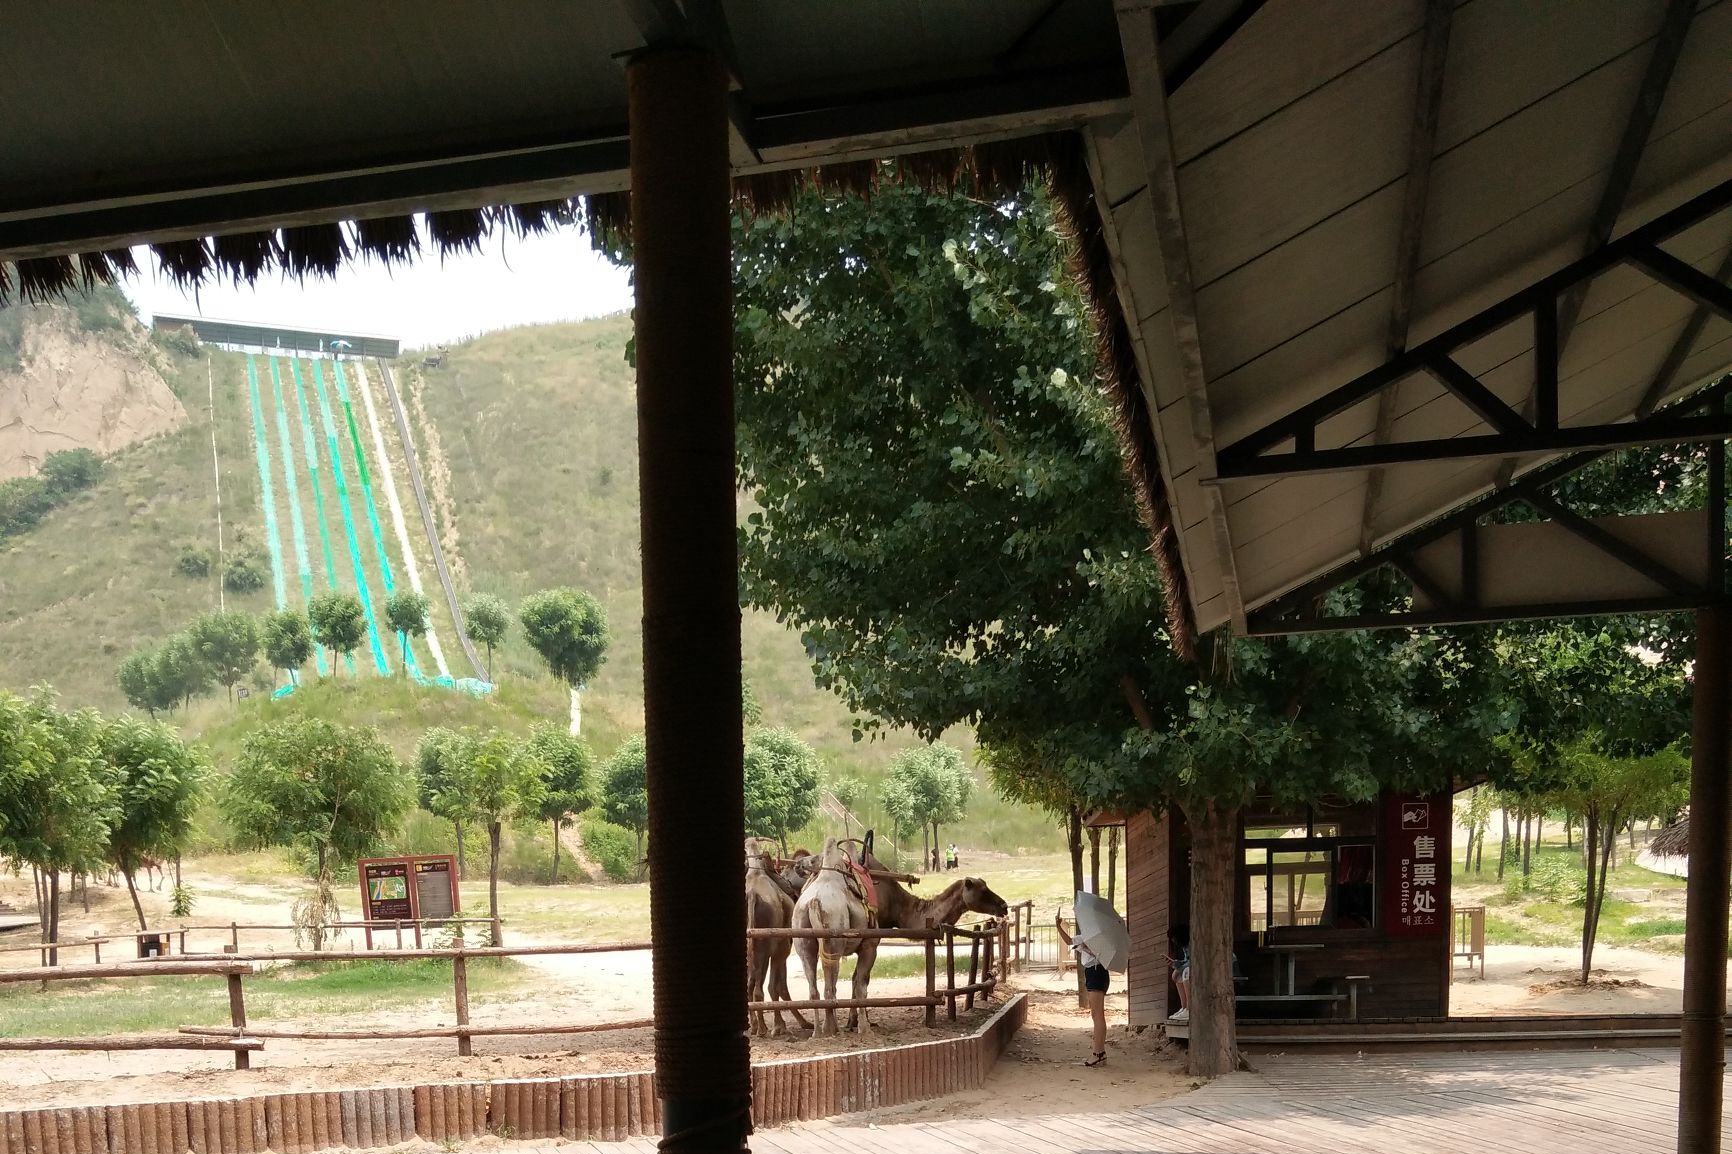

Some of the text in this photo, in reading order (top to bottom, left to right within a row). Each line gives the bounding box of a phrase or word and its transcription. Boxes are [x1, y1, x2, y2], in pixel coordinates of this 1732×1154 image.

[1401, 858, 1410, 914] Box Office
[1412, 835, 1437, 914] 售票处
[1402, 915, 1435, 926] 매표소
